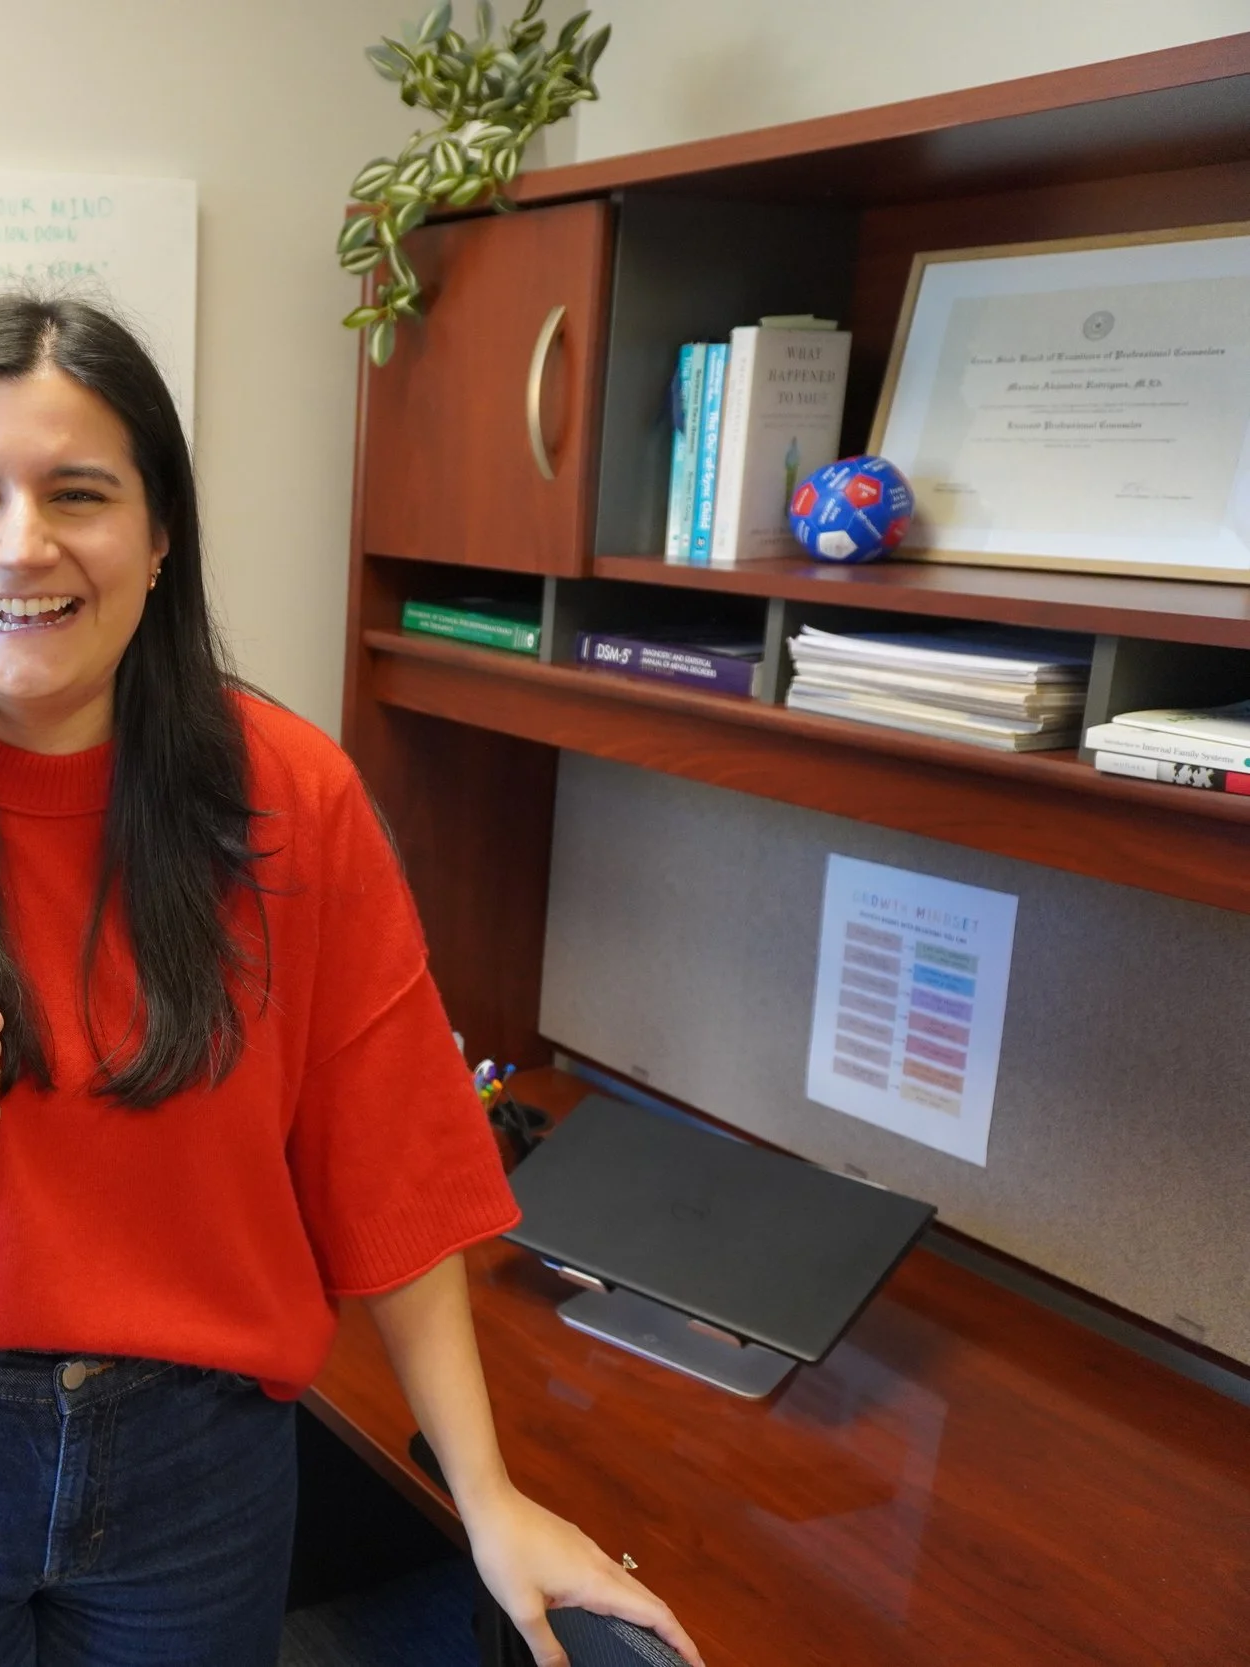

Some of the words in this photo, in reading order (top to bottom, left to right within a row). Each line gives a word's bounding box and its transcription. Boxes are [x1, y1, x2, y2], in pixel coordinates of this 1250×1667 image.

[51, 195, 114, 220] MIND
[34, 225, 79, 244] DOWN
[787, 345, 823, 361] WHAT
[1114, 348, 1172, 361] Professional
[768, 368, 836, 384] HAPPENED
[777, 389, 794, 406] TO
[707, 411, 720, 431] The
[698, 500, 712, 531] Child
[642, 647, 673, 659] DIAGNOSTIC
[672, 652, 685, 662] AND
[684, 653, 712, 668] STATISTICAL
[641, 657, 663, 667] MANUAL
[662, 660, 670, 668] OF
[670, 661, 689, 673] MENTAL
[688, 665, 717, 679] DISORDERS
[1141, 742, 1172, 755] Internal
[1173, 747, 1200, 760] Family
[1200, 752, 1235, 764] Systems
